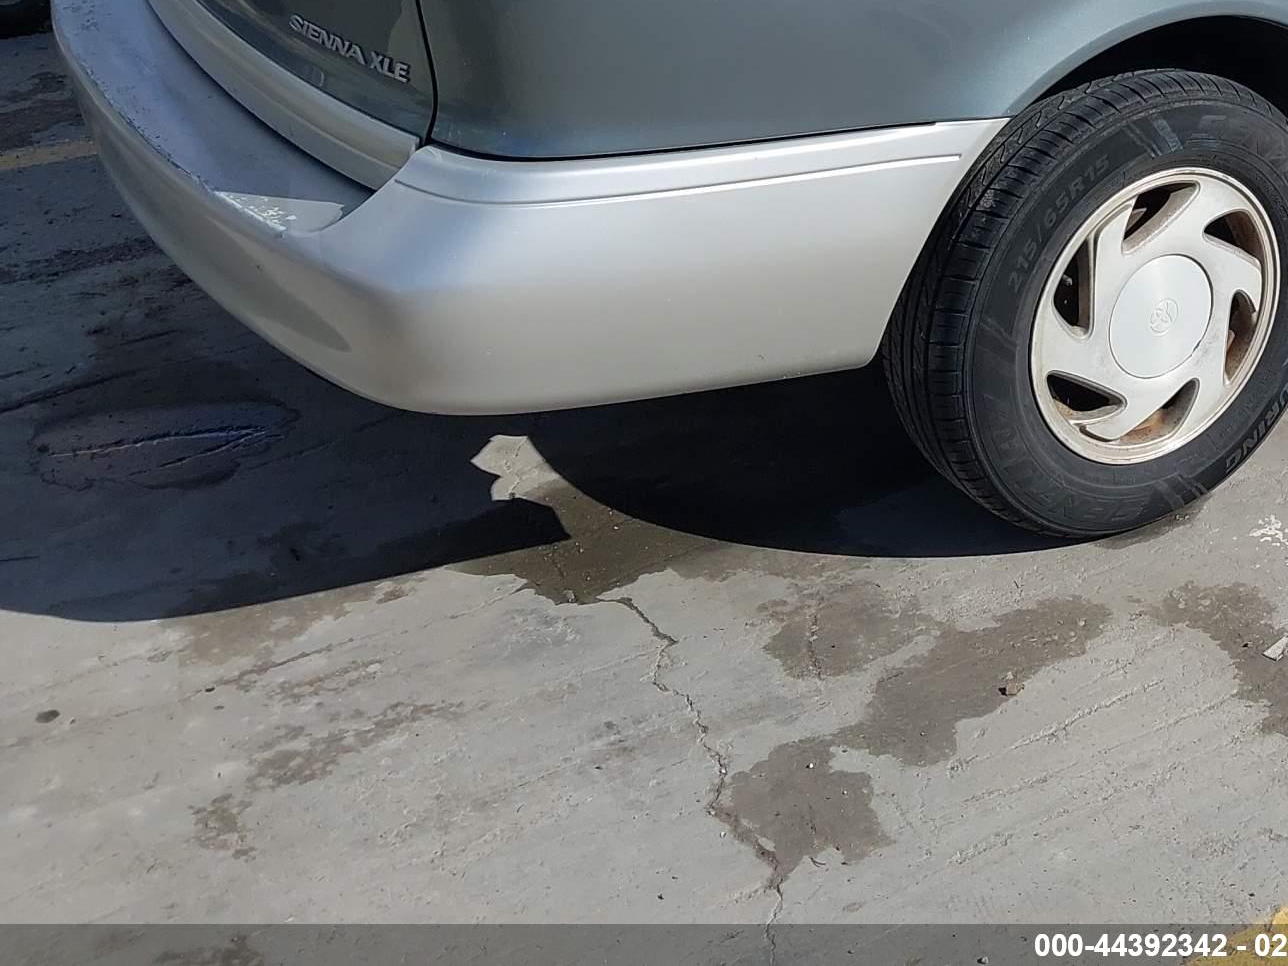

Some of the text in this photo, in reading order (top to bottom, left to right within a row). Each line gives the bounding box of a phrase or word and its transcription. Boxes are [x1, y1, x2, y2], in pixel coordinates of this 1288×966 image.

[288, 14, 409, 83] SIENNA XLE
[1008, 154, 1110, 292] 215/65R15
